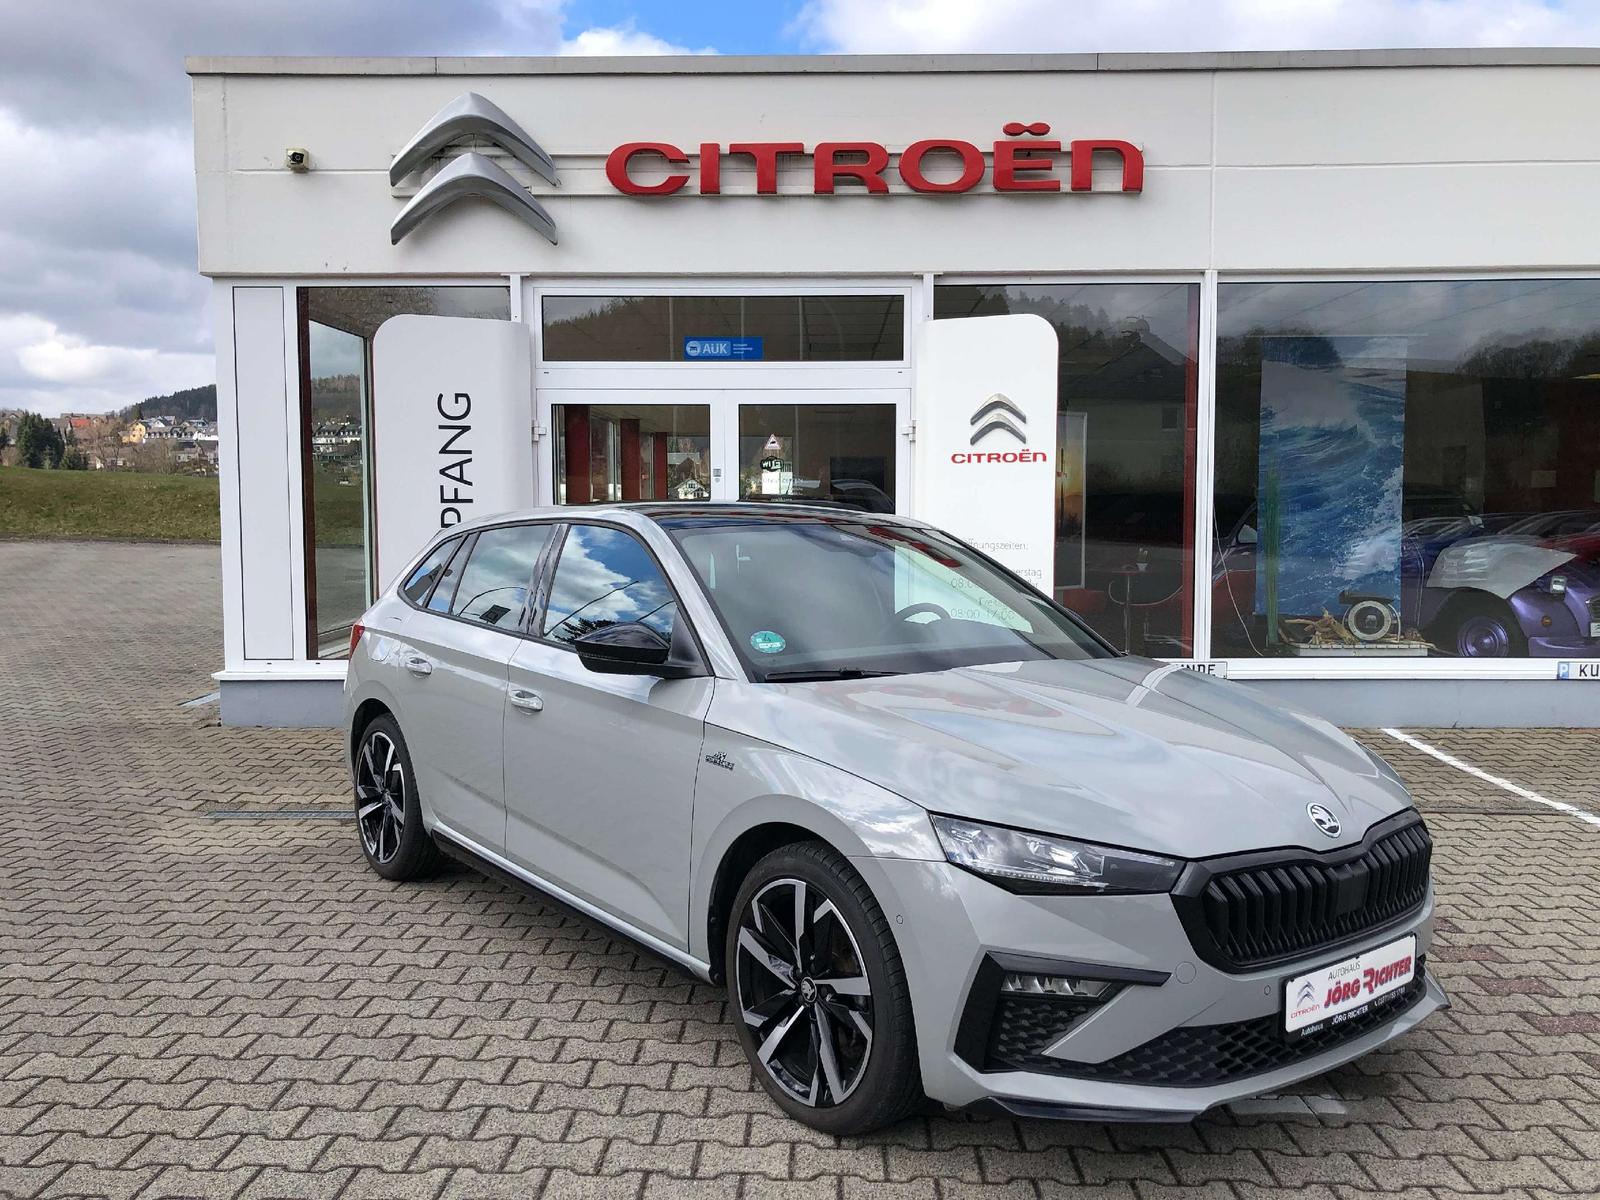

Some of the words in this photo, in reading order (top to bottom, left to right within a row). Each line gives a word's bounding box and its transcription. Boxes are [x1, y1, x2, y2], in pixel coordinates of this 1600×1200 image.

[605, 122, 1144, 195] CITROËN
[951, 448, 1047, 464] CITROËN
[1328, 961, 1361, 980] AUTOHAUS
[1324, 979, 1361, 1008] JÖRG
[1363, 955, 1412, 995] RICHTER
[1331, 1013, 1347, 1025] JÖRG
[1347, 1005, 1369, 1019] RICHTER
